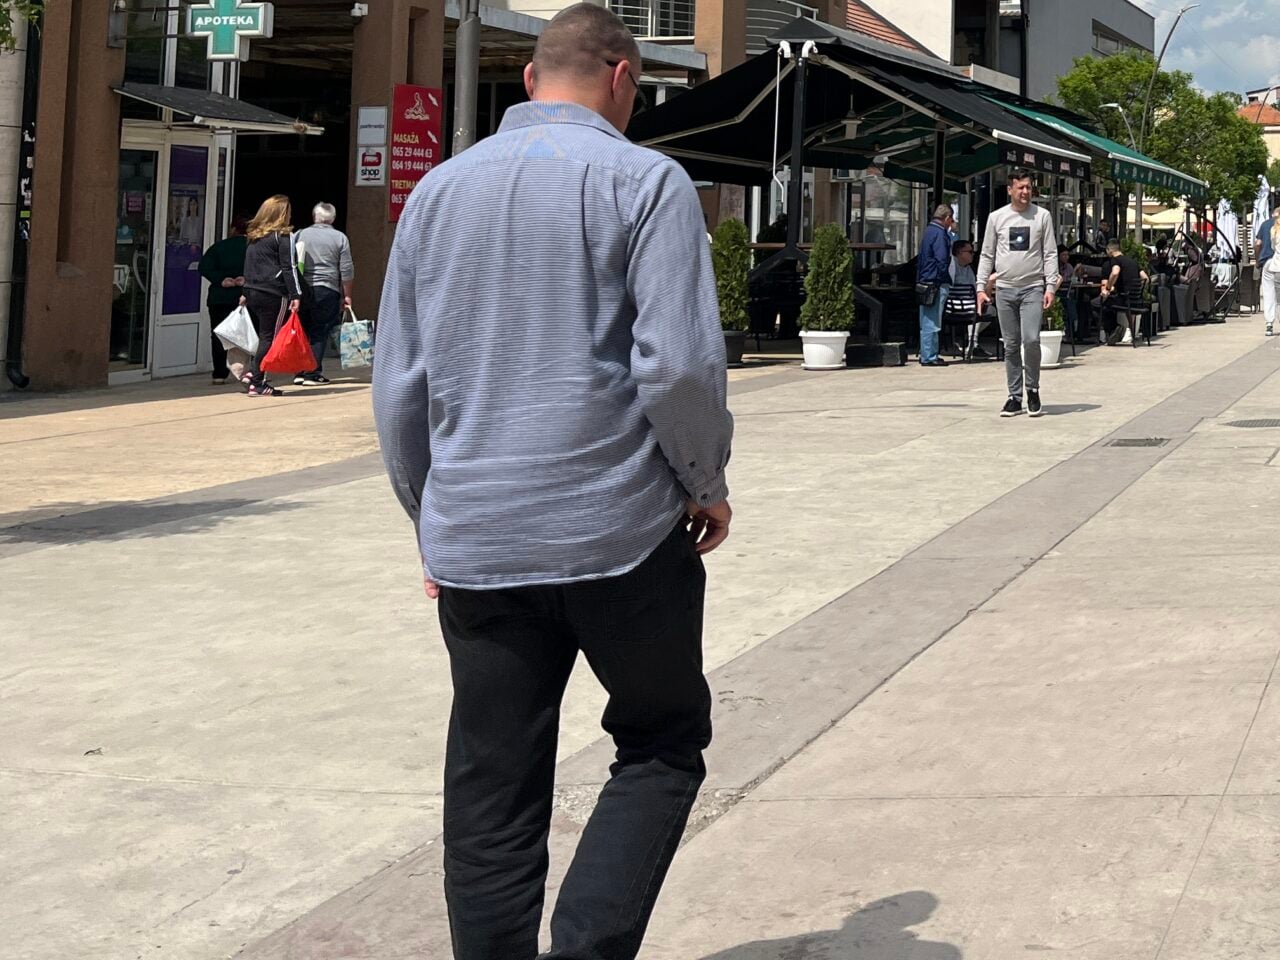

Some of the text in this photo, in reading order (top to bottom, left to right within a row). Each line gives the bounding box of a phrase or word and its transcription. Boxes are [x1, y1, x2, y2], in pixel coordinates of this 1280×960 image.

[194, 15, 254, 26] APOTEKA
[393, 131, 420, 144] MASAŽA
[392, 146, 404, 157] 065
[404, 147, 413, 157] 29
[413, 147, 425, 158] 444
[392, 159, 404, 170] 064
[404, 160, 412, 170] 19
[412, 161, 424, 171] 444
[360, 167, 380, 178] shop
